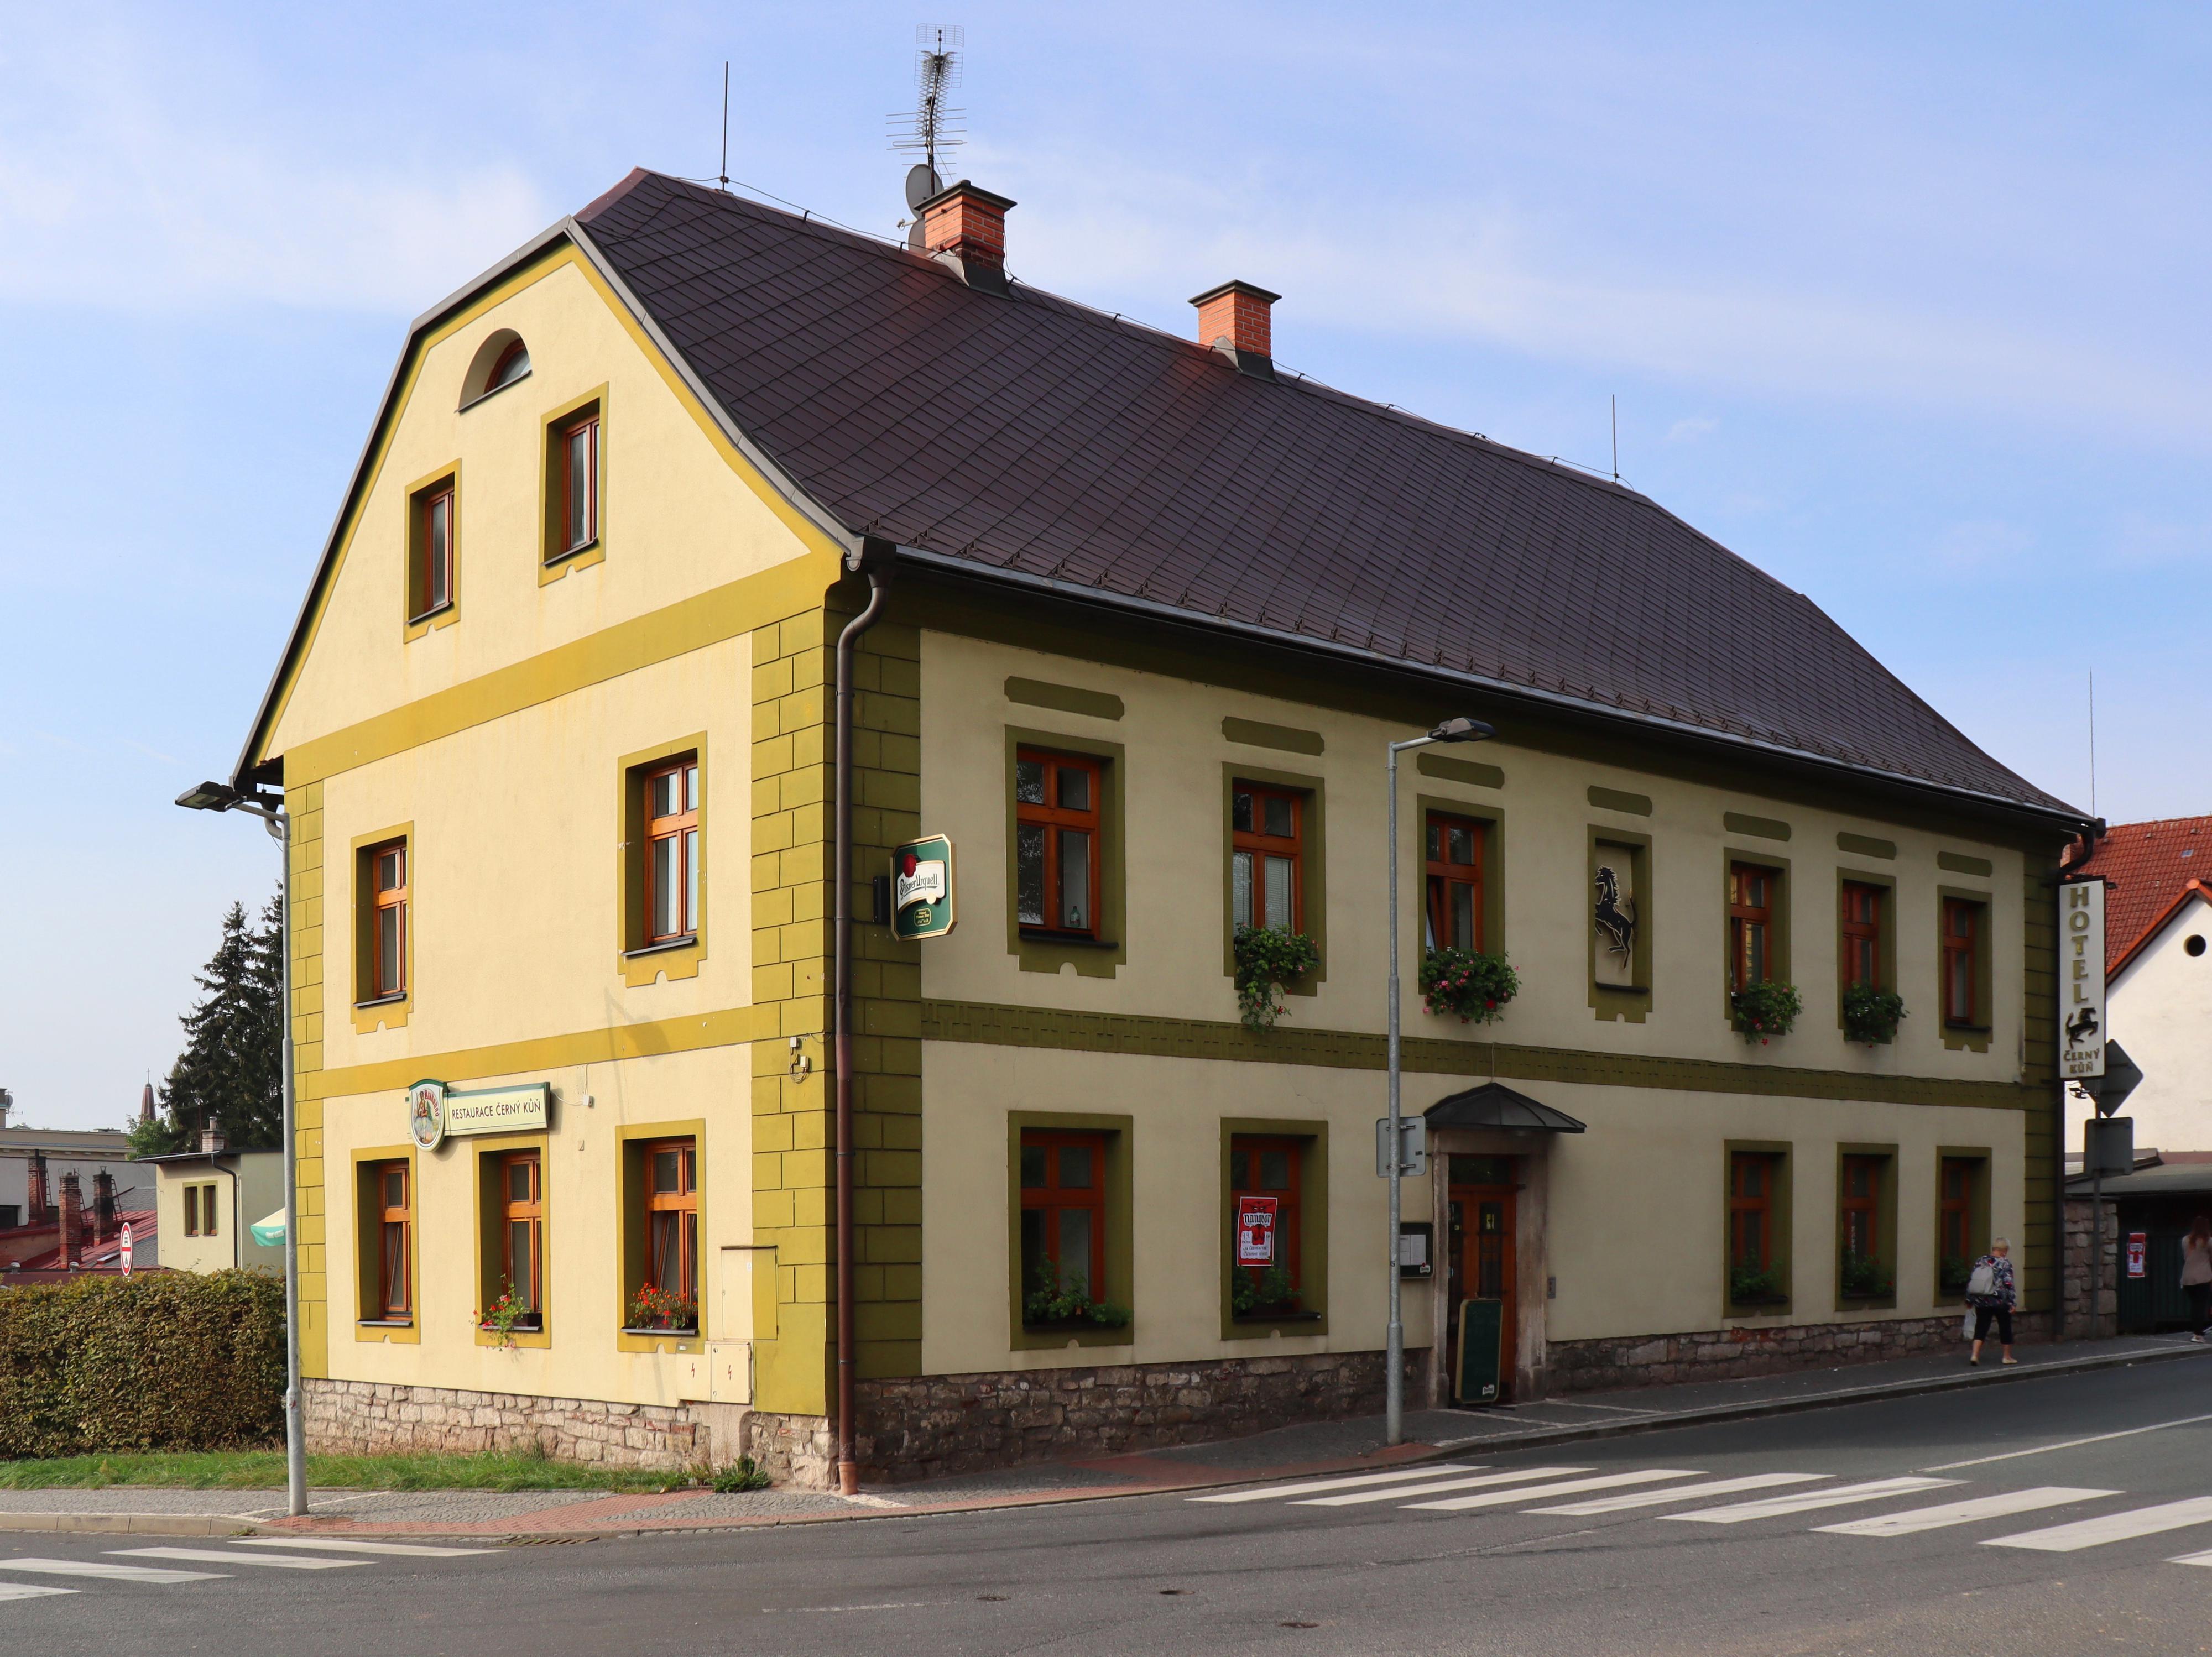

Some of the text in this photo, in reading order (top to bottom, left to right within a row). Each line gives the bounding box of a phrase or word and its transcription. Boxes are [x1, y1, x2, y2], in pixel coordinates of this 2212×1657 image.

[900, 874, 937, 900] Pilsner Urquell
[2069, 886, 2089, 1003] HOTEL
[2063, 1048, 2100, 1061] ČERNÝ
[452, 1097, 541, 1120] RESTAURACE ČERNÝ KŮŇ
